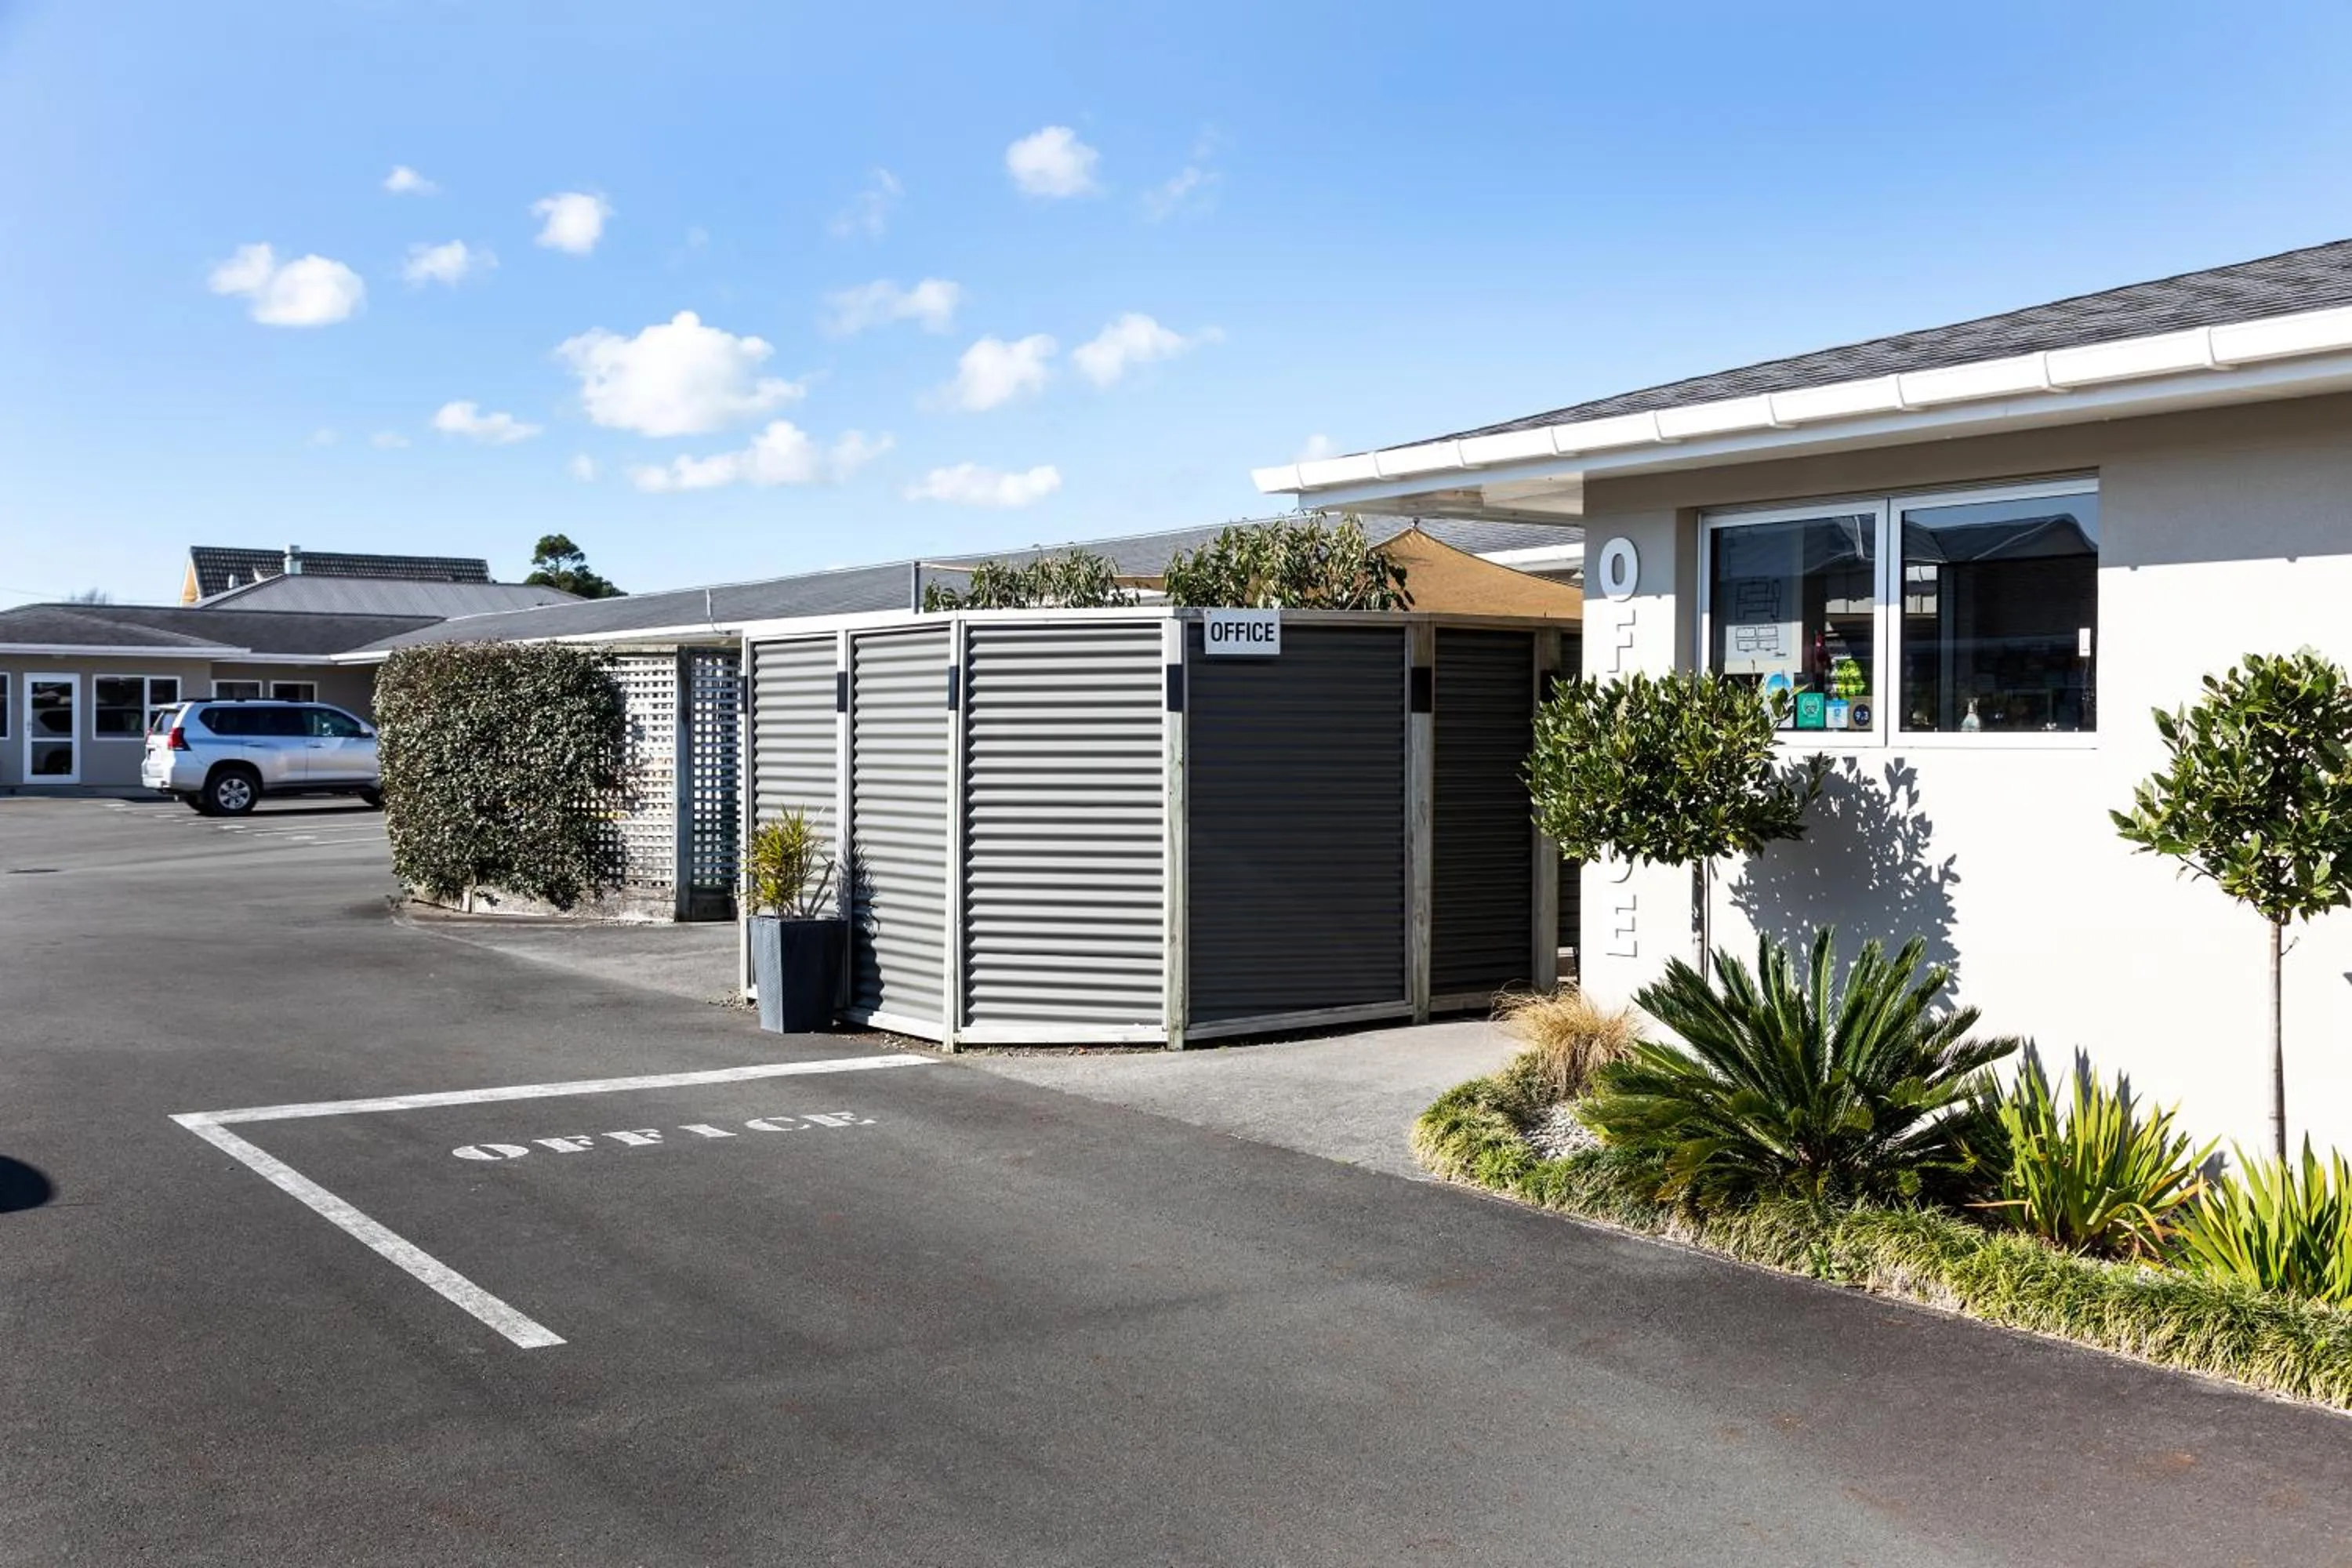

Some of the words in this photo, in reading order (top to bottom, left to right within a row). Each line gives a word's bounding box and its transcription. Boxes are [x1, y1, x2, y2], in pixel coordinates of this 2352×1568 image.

[1210, 622, 1275, 642] OFFICE
[1599, 537, 1639, 958] OFE
[452, 1111, 877, 1160] OFFICE
